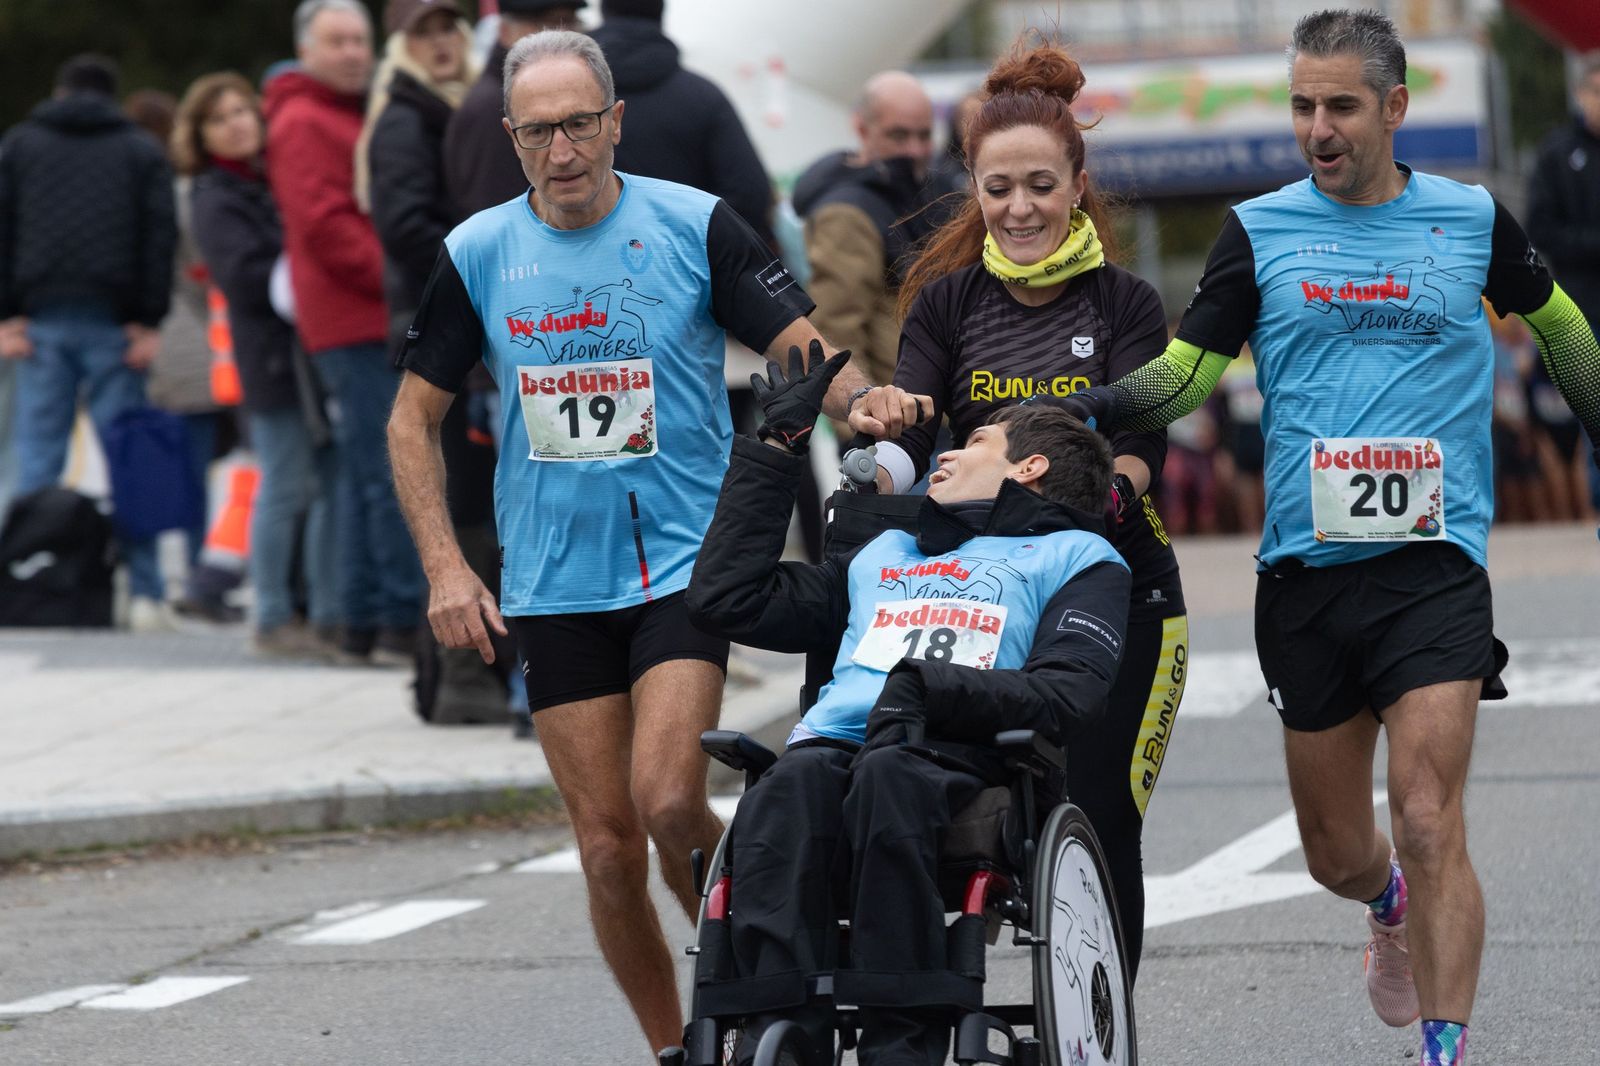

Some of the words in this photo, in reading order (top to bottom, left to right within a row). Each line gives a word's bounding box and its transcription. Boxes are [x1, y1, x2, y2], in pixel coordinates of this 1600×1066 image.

[1358, 310, 1438, 331] FLOWERS
[560, 340, 638, 361] FLOWERS
[521, 367, 651, 396] bedunia
[559, 395, 616, 438] 19
[1314, 445, 1440, 470] bedunia
[1350, 473, 1408, 517] 20
[873, 604, 1001, 635] bedunia
[902, 628, 957, 663] 18
